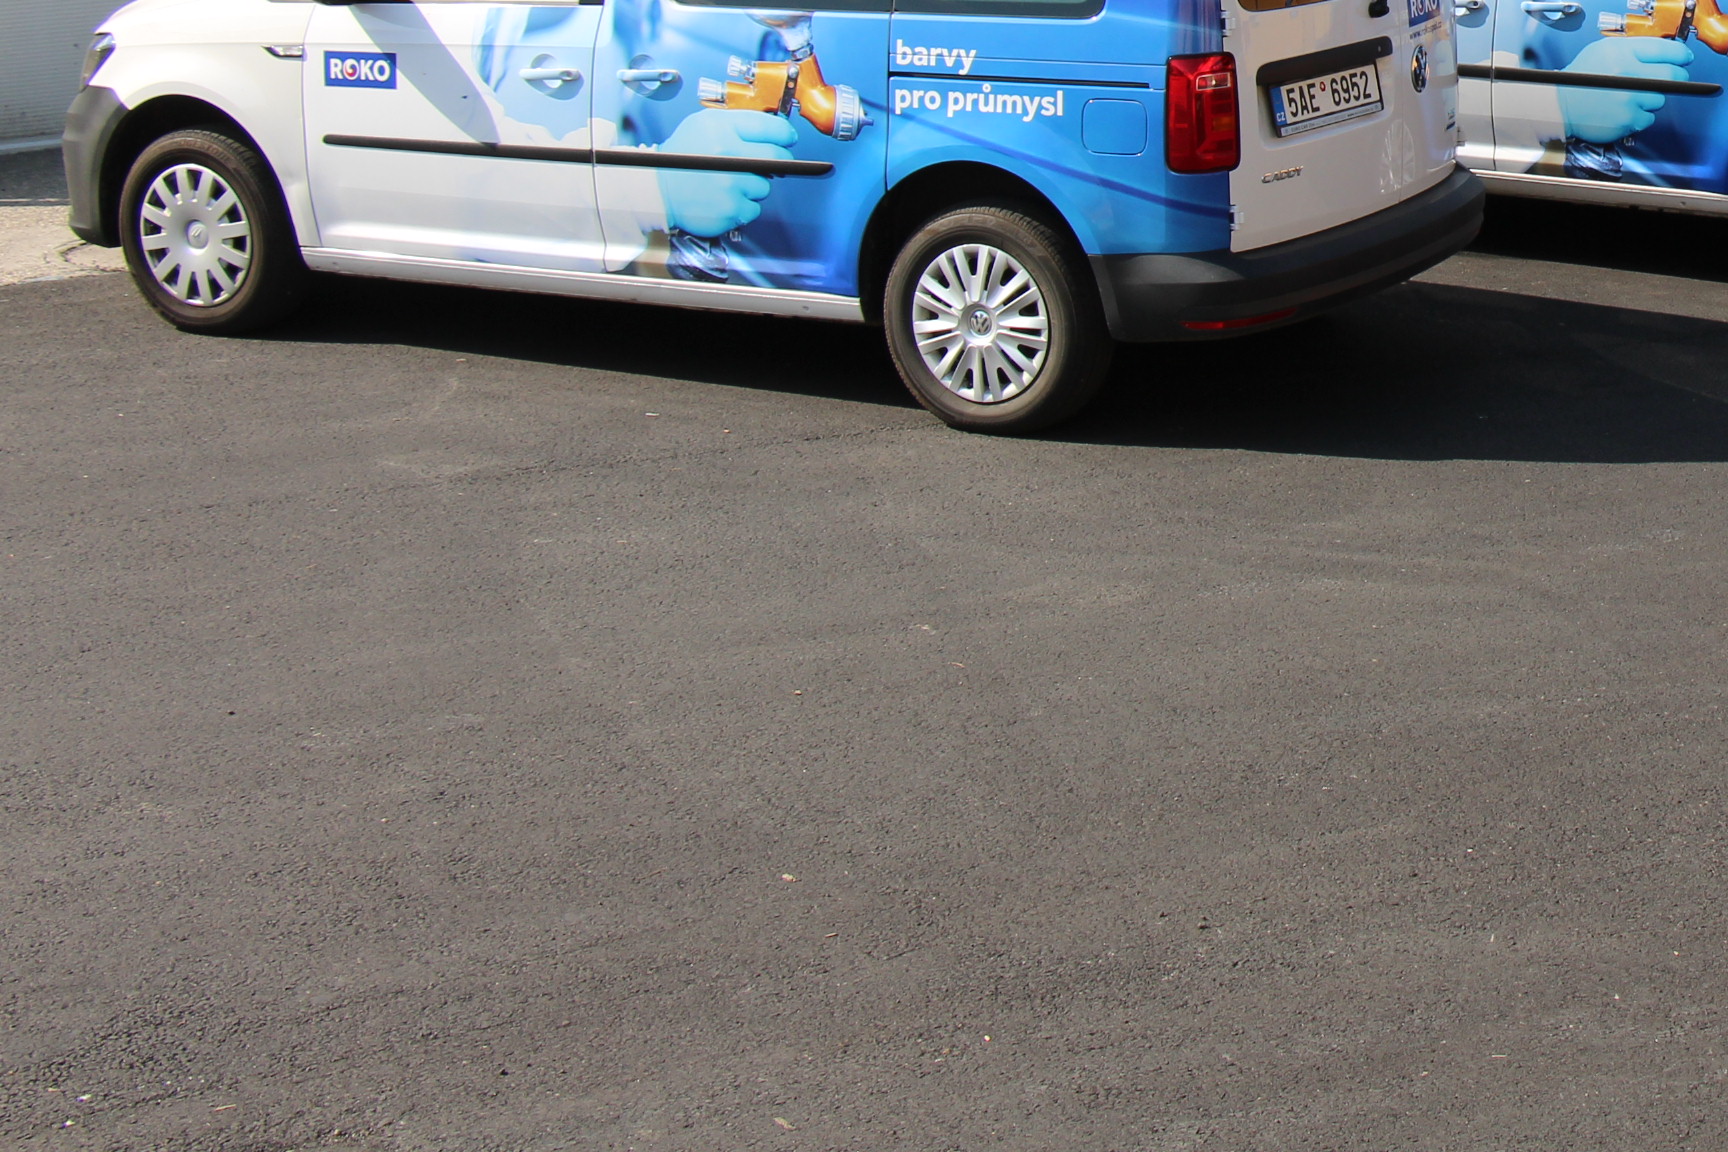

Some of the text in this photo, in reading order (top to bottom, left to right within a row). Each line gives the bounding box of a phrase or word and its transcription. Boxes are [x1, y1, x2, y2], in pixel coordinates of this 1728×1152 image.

[329, 57, 391, 83] ROKO
[895, 38, 977, 76] barvy
[894, 83, 1064, 122] pro průmysl
[1286, 70, 1372, 118] 5AE 6952
[1276, 111, 1286, 122] CZ
[1261, 165, 1304, 184] CADDY
